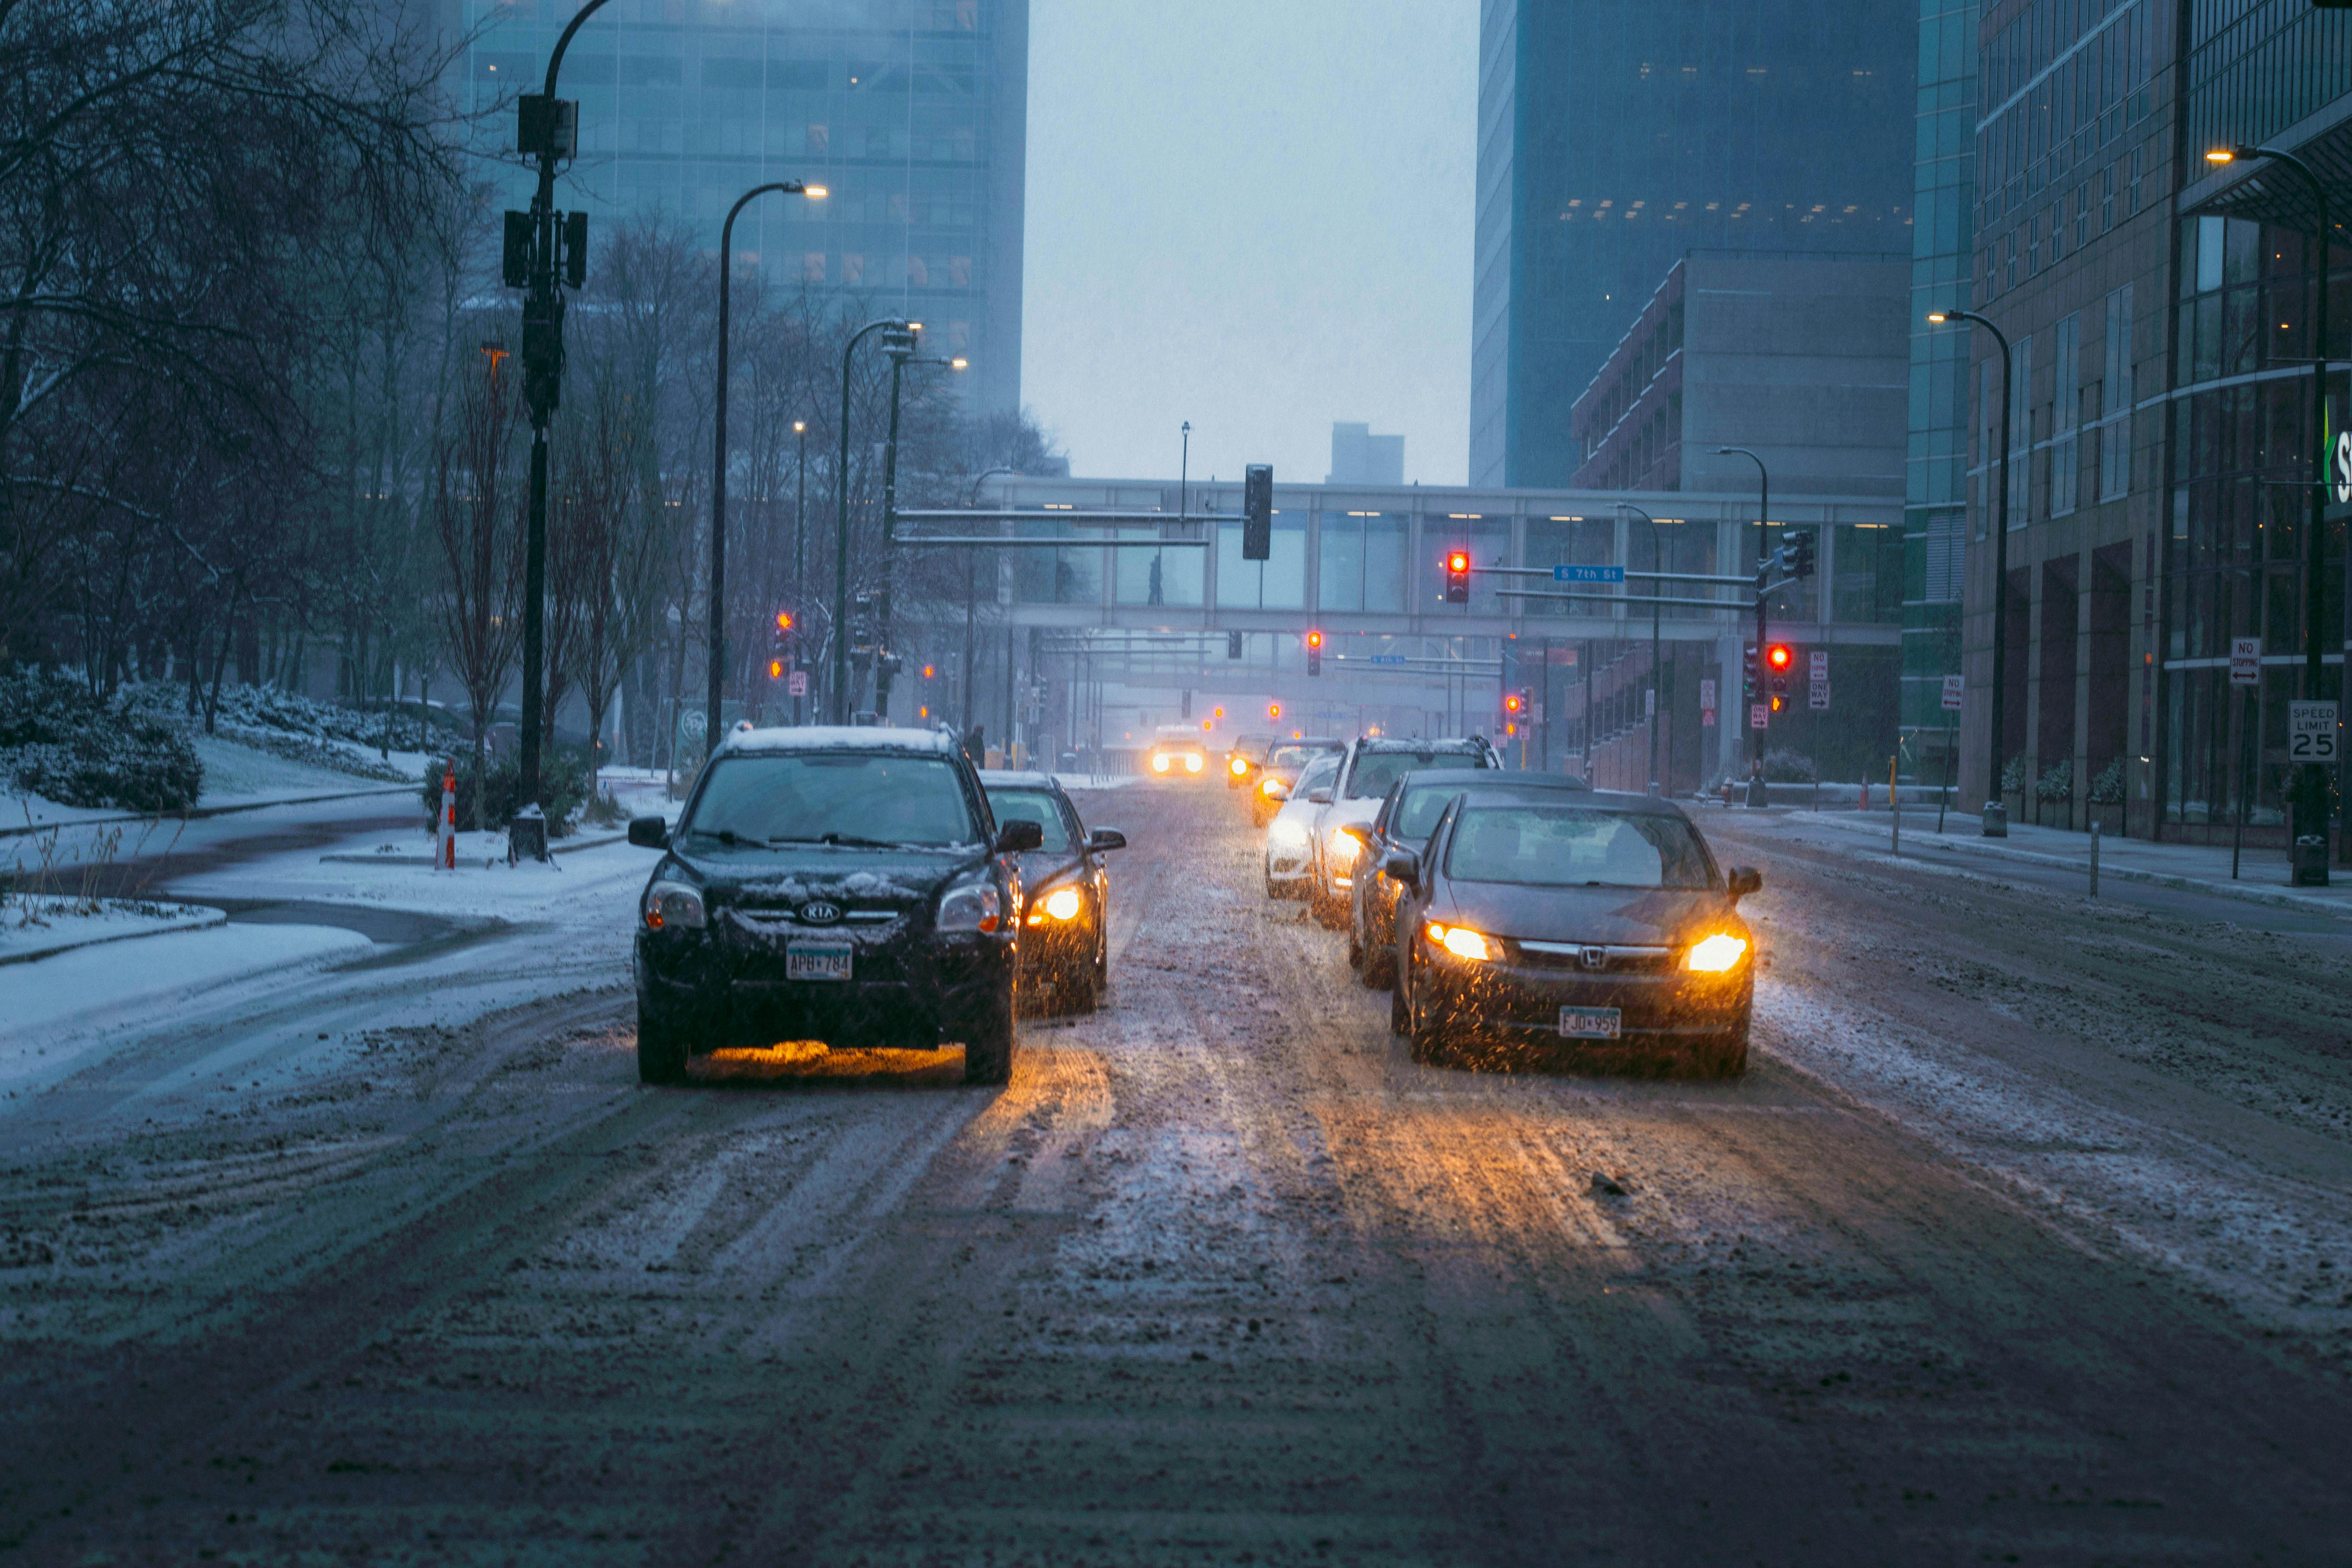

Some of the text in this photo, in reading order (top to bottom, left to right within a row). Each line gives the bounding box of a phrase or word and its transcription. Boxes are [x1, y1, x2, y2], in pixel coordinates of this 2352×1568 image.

[2338, 431, 2352, 503] S
[1576, 568, 1597, 579] 7th
[1603, 569, 1617, 580] St
[2238, 643, 2253, 654] NO
[1814, 653, 1824, 661] NO
[2233, 658, 2258, 667] STOPPING
[1948, 678, 1959, 687] NO
[2293, 709, 2335, 718] SPEED
[2297, 721, 2330, 731] LIMIT
[2293, 734, 2333, 756] 25
[808, 907, 834, 918] KIA
[1595, 1016, 1617, 1032] 959
